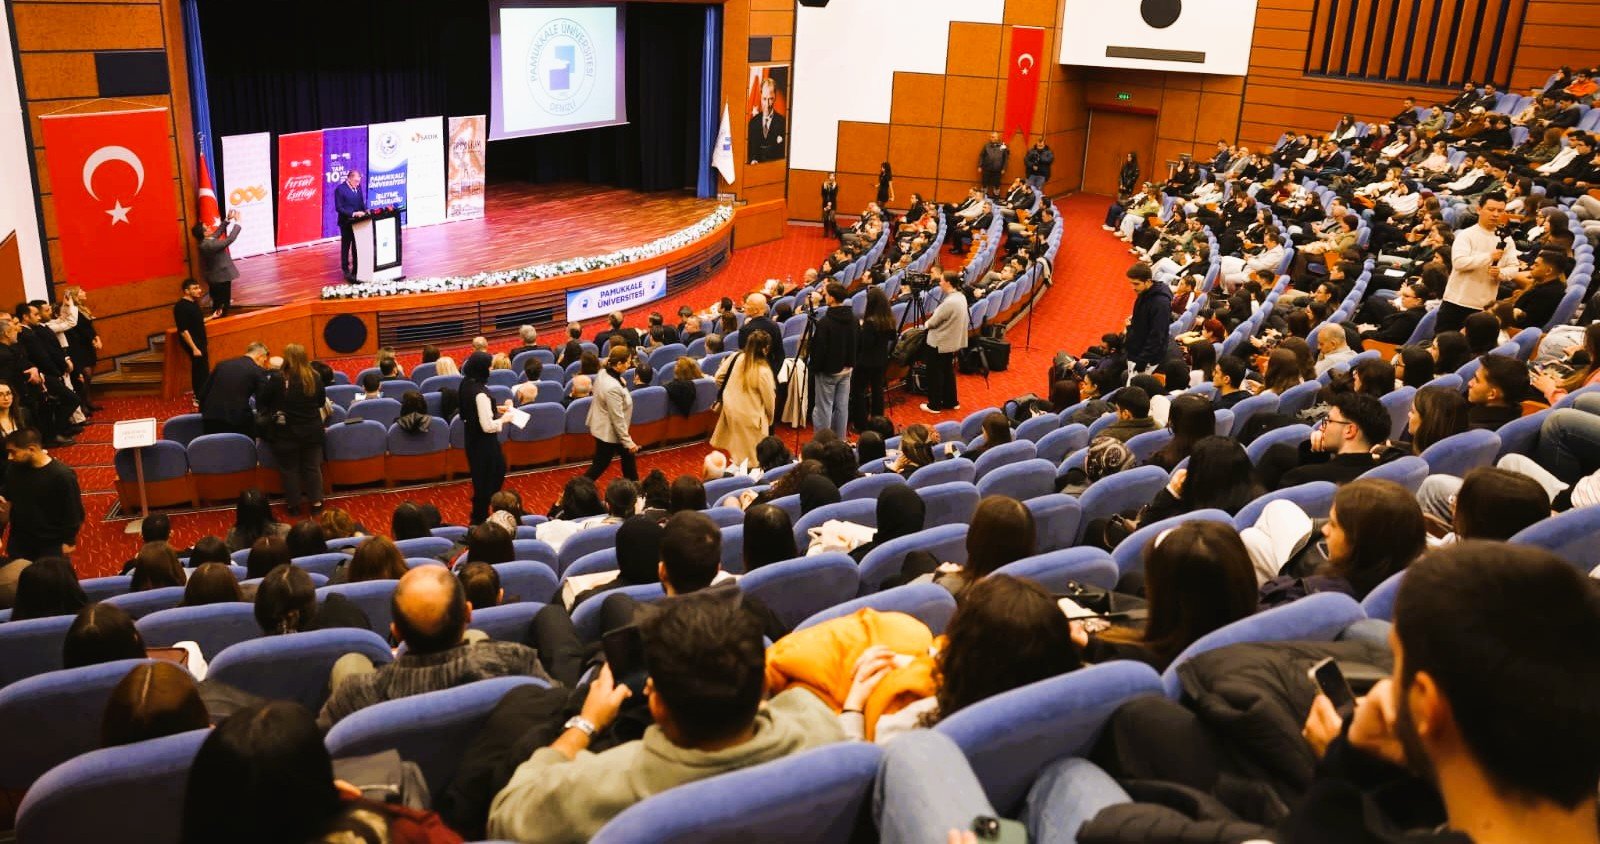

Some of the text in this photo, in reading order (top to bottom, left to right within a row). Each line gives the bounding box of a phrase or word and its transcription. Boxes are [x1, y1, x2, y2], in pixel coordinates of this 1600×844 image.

[529, 23, 559, 82] PAMUKKALE
[325, 171, 341, 183] 10
[370, 172, 405, 182] PAMUKKALE
[600, 281, 643, 298] PAMUKKALE
